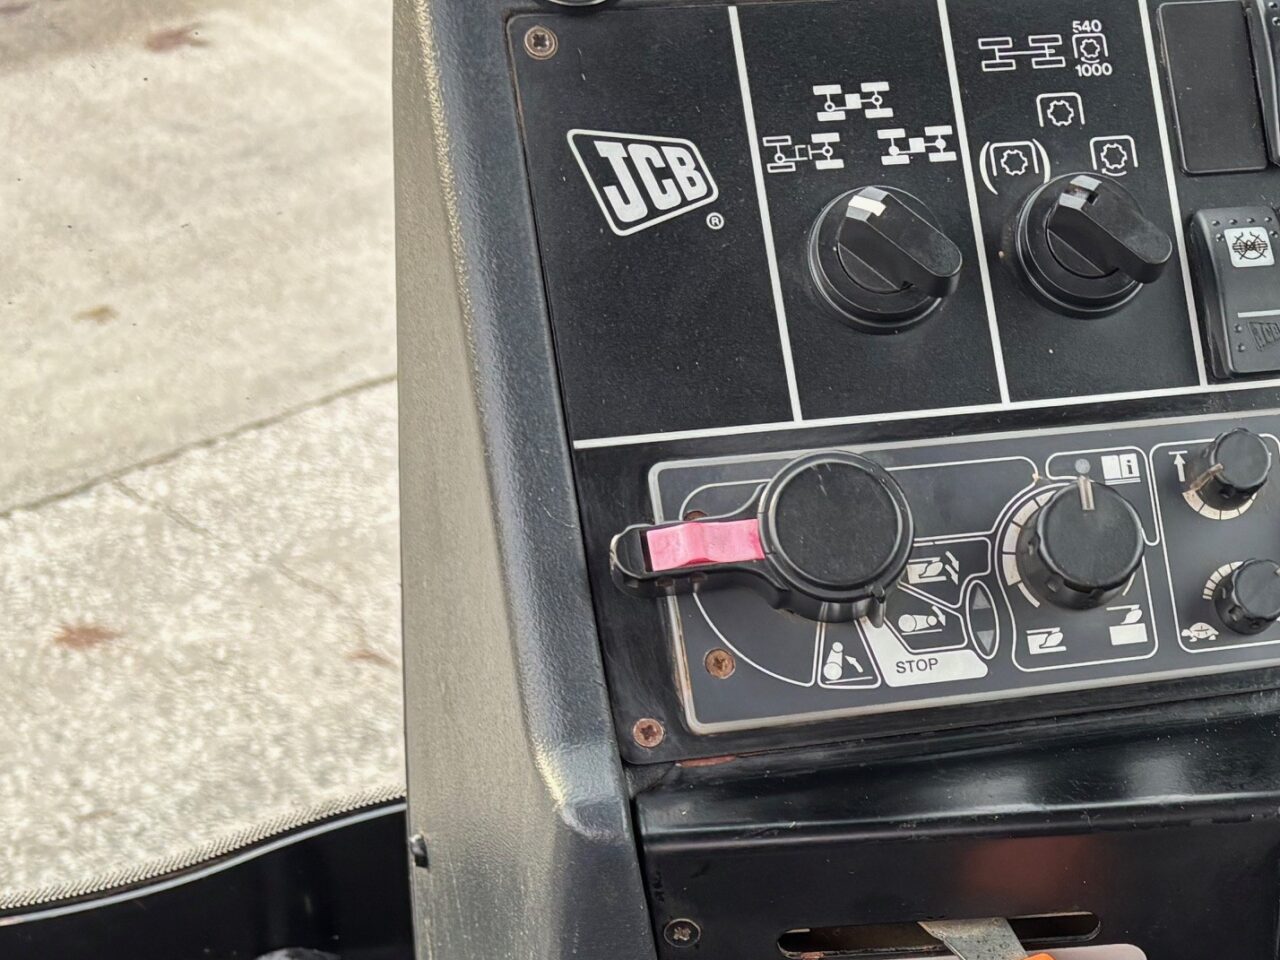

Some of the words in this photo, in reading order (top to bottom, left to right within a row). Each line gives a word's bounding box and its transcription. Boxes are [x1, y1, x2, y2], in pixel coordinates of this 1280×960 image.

[1072, 19, 1102, 33] 540
[1075, 62, 1113, 77] 1000
[594, 141, 707, 222] JCB
[896, 657, 939, 674] STOP
